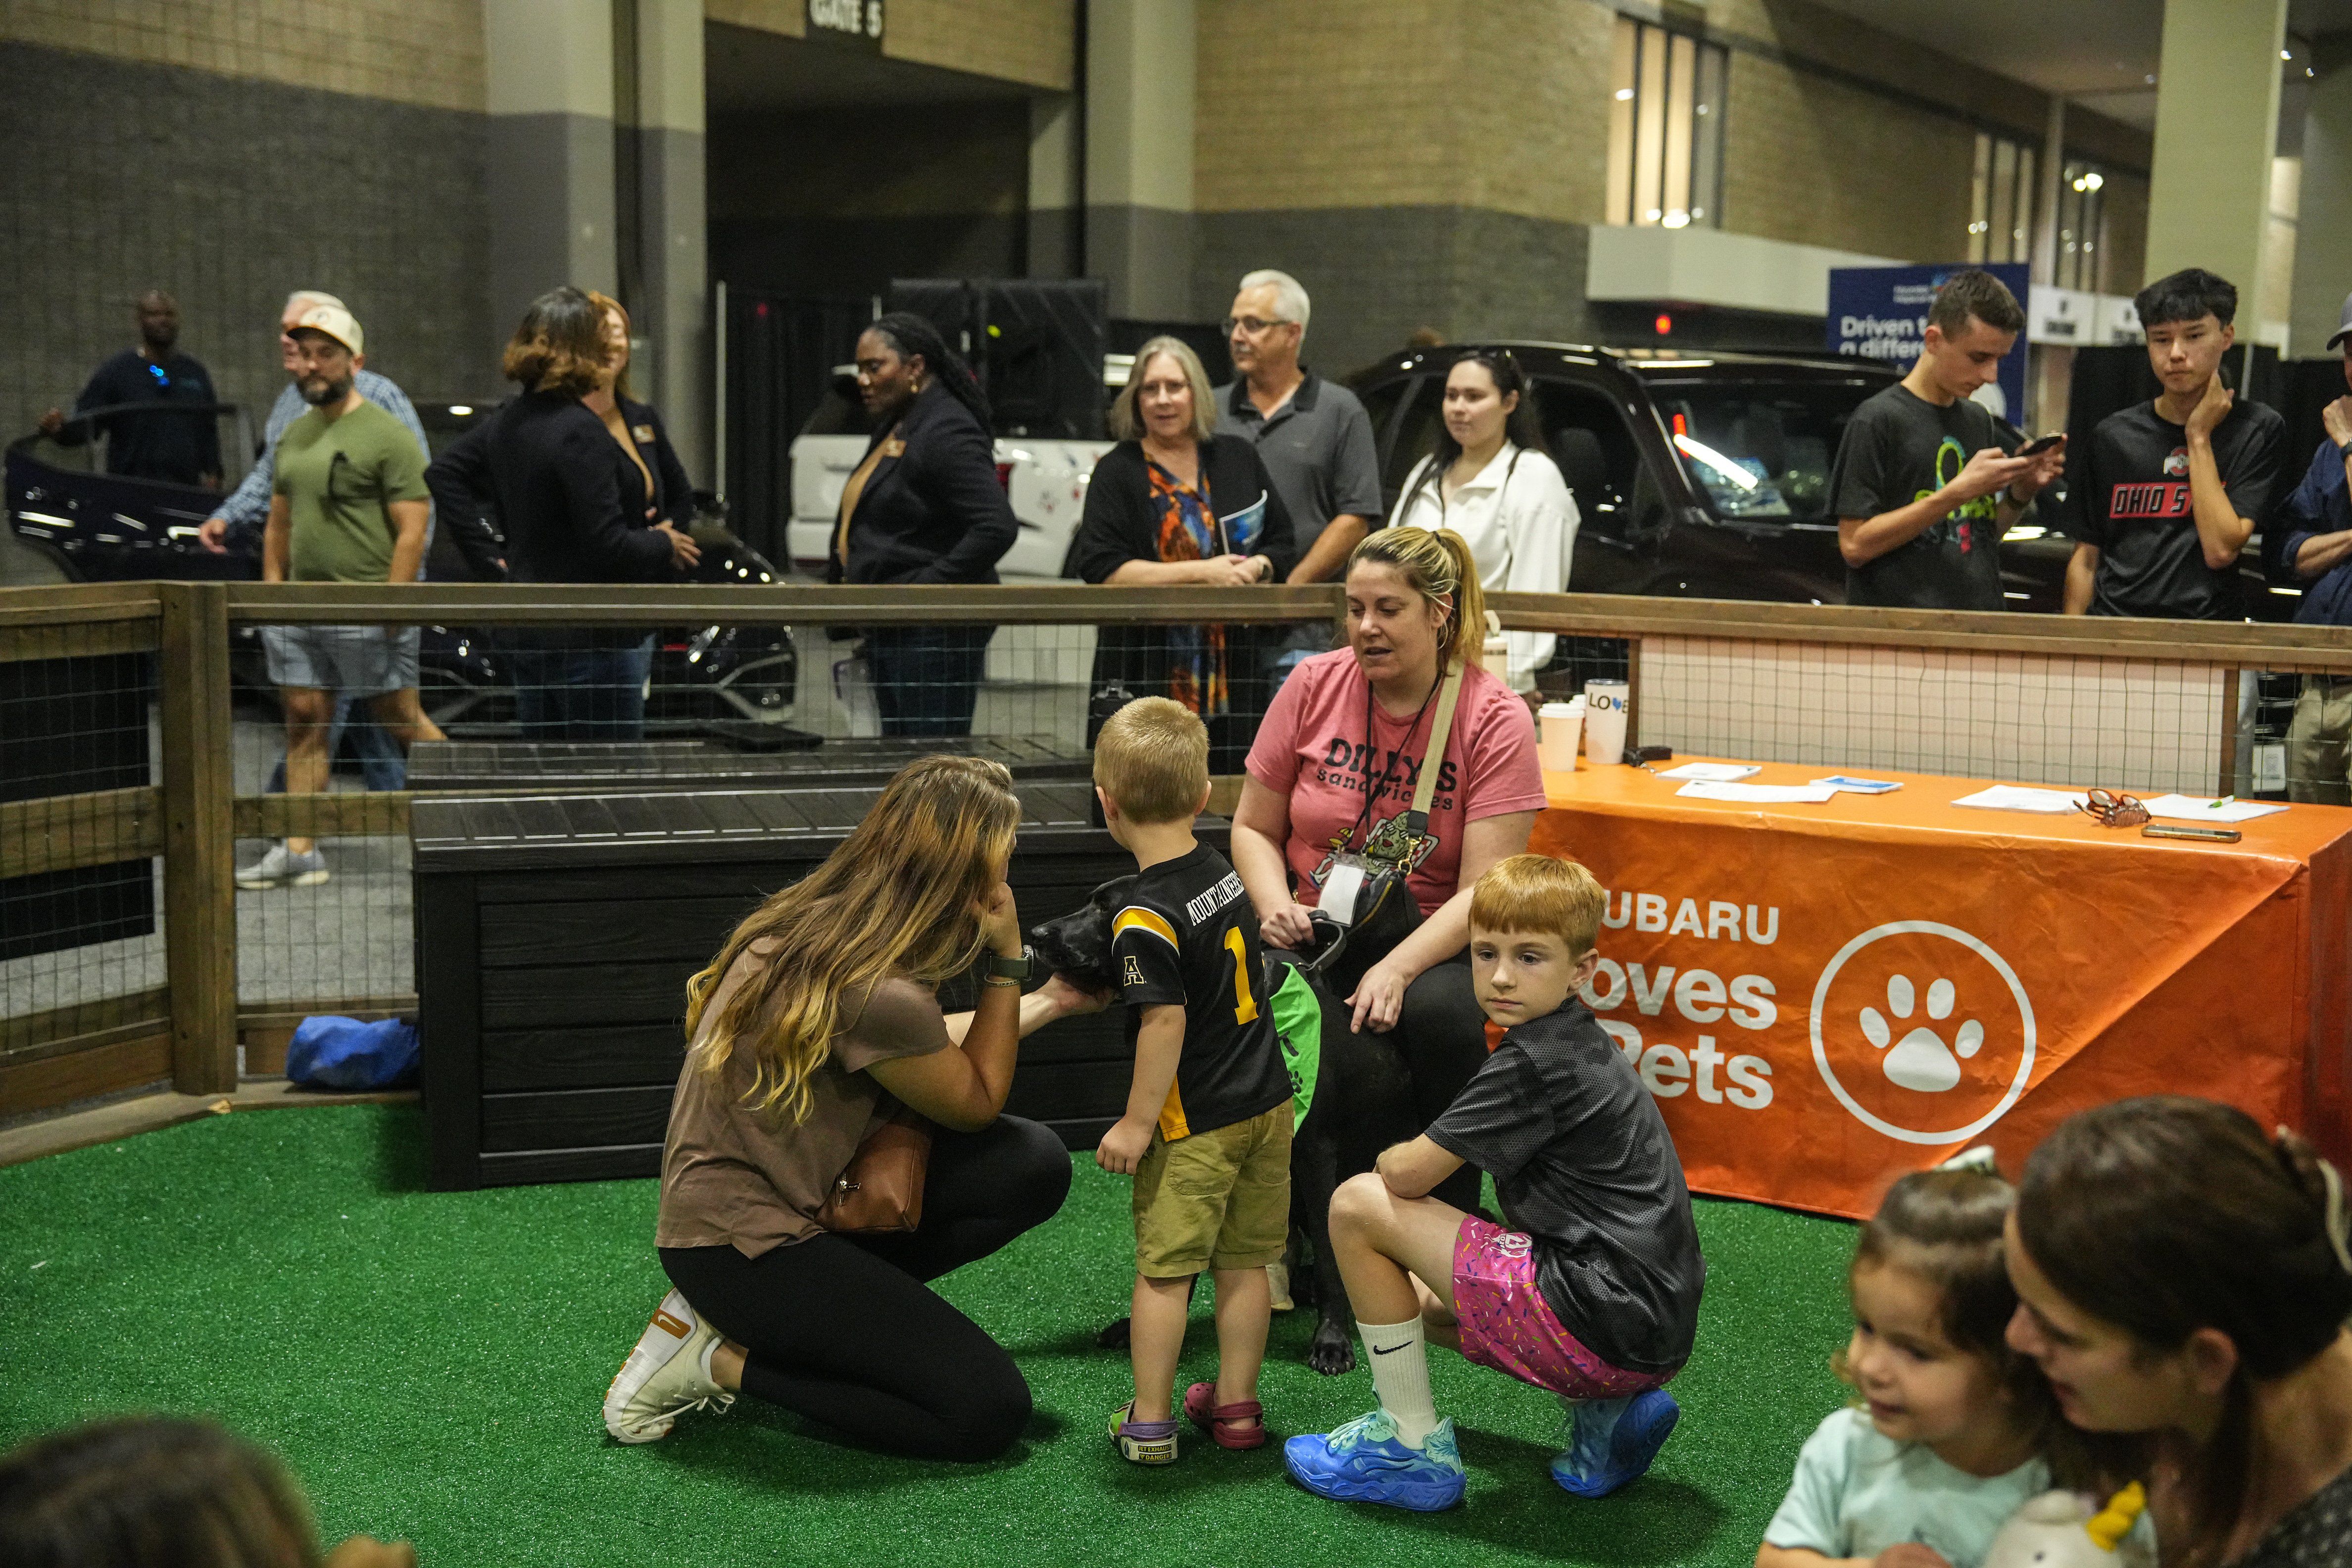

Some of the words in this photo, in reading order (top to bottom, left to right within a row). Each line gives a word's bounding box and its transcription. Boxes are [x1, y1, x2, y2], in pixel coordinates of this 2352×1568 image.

[1840, 314, 1915, 338] Driven
[1859, 335, 1925, 359] differ
[2114, 486, 2165, 513] OHIO
[1324, 738, 1457, 791] DILLYS
[1602, 889, 1779, 945] UBARU
[1224, 926, 1259, 1025] 1
[1579, 957, 1777, 1030] oves
